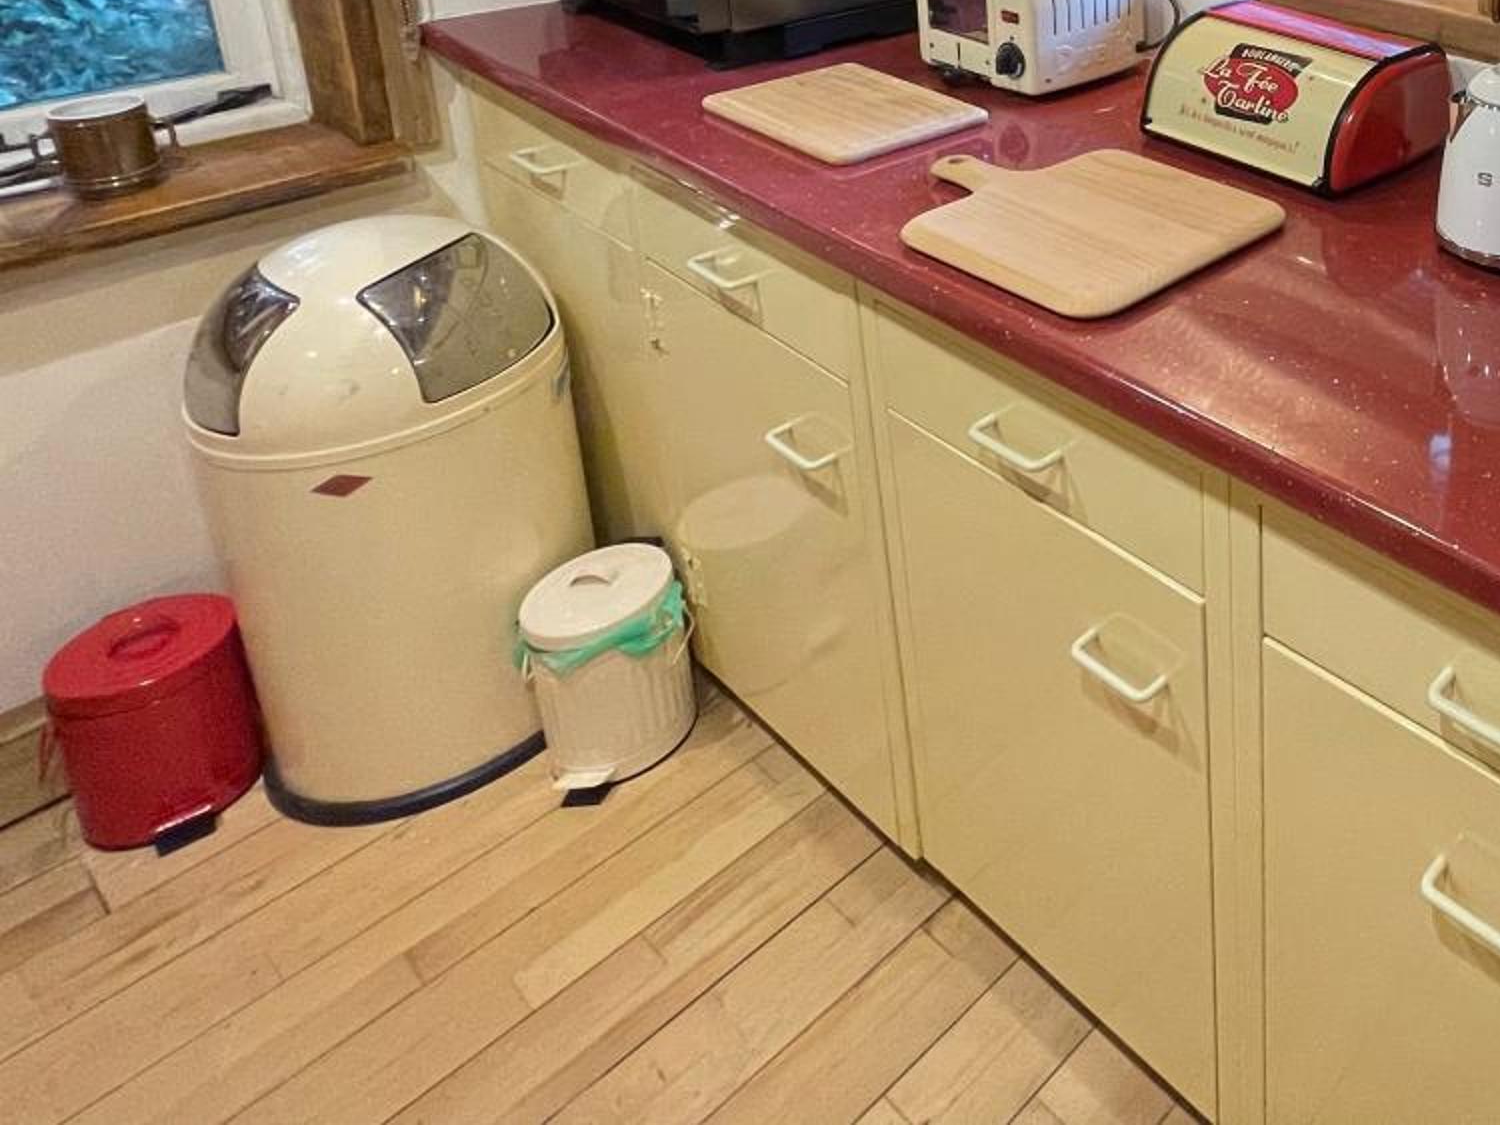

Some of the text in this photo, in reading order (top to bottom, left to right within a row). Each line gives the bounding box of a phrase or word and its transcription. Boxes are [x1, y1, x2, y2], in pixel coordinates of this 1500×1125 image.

[1203, 57, 1279, 95] La Fée
[1217, 80, 1289, 123] Tartine
